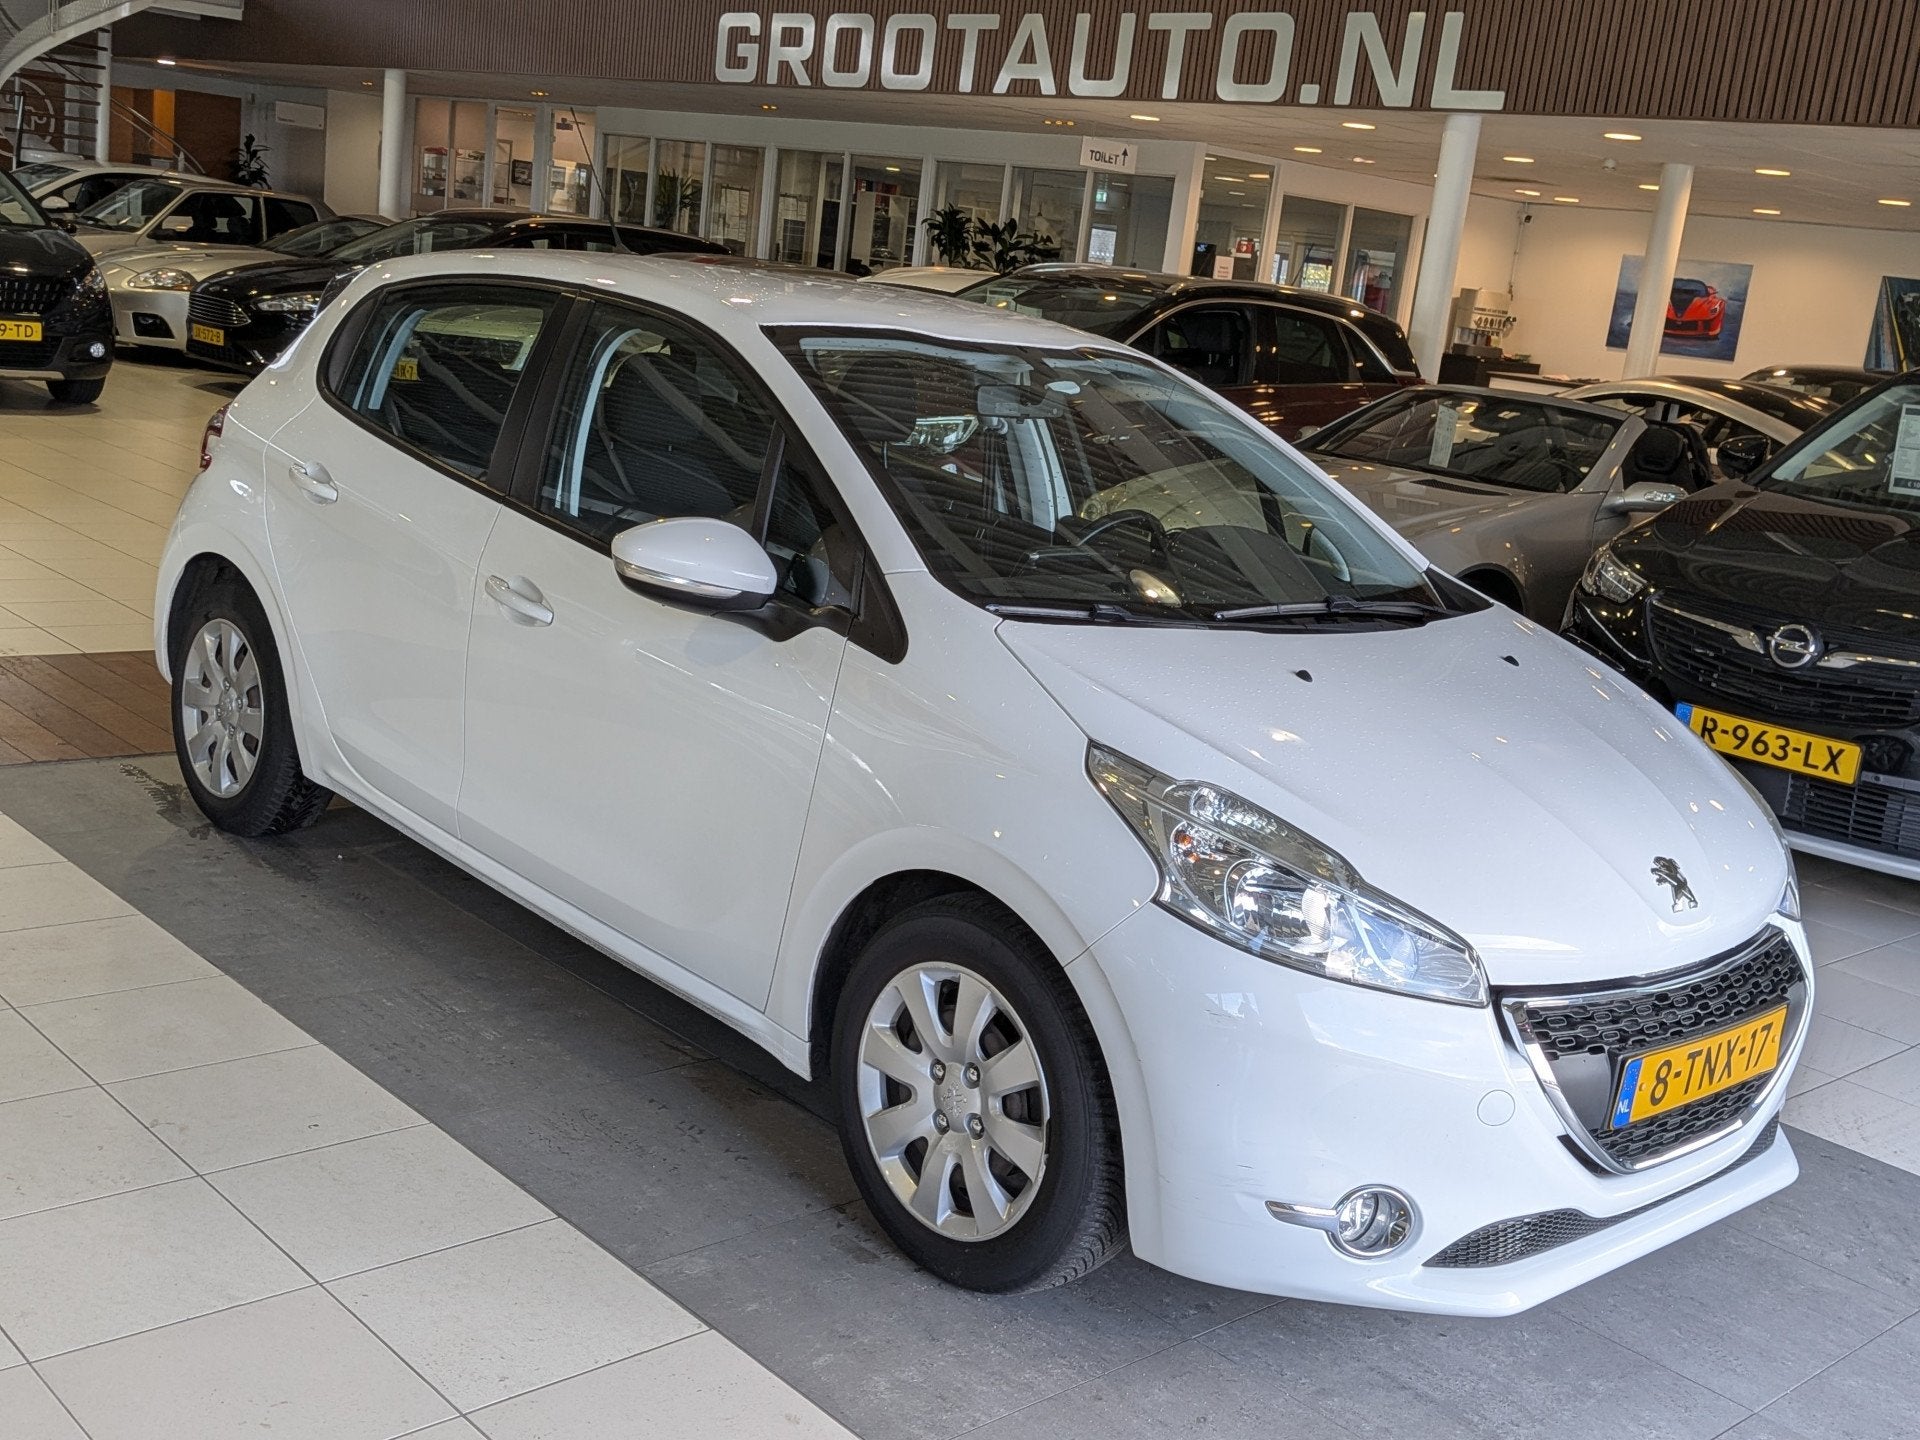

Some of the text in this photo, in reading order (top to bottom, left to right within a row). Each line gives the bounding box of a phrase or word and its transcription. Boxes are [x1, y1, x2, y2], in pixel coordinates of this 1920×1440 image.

[714, 11, 1506, 111] GROOTAUTO.NL
[1089, 149, 1120, 165] TOILET
[1700, 715, 1845, 776] R-963-LX
[1650, 1021, 1774, 1107] 8-TNX-17
[1616, 1100, 1630, 1115] NL
